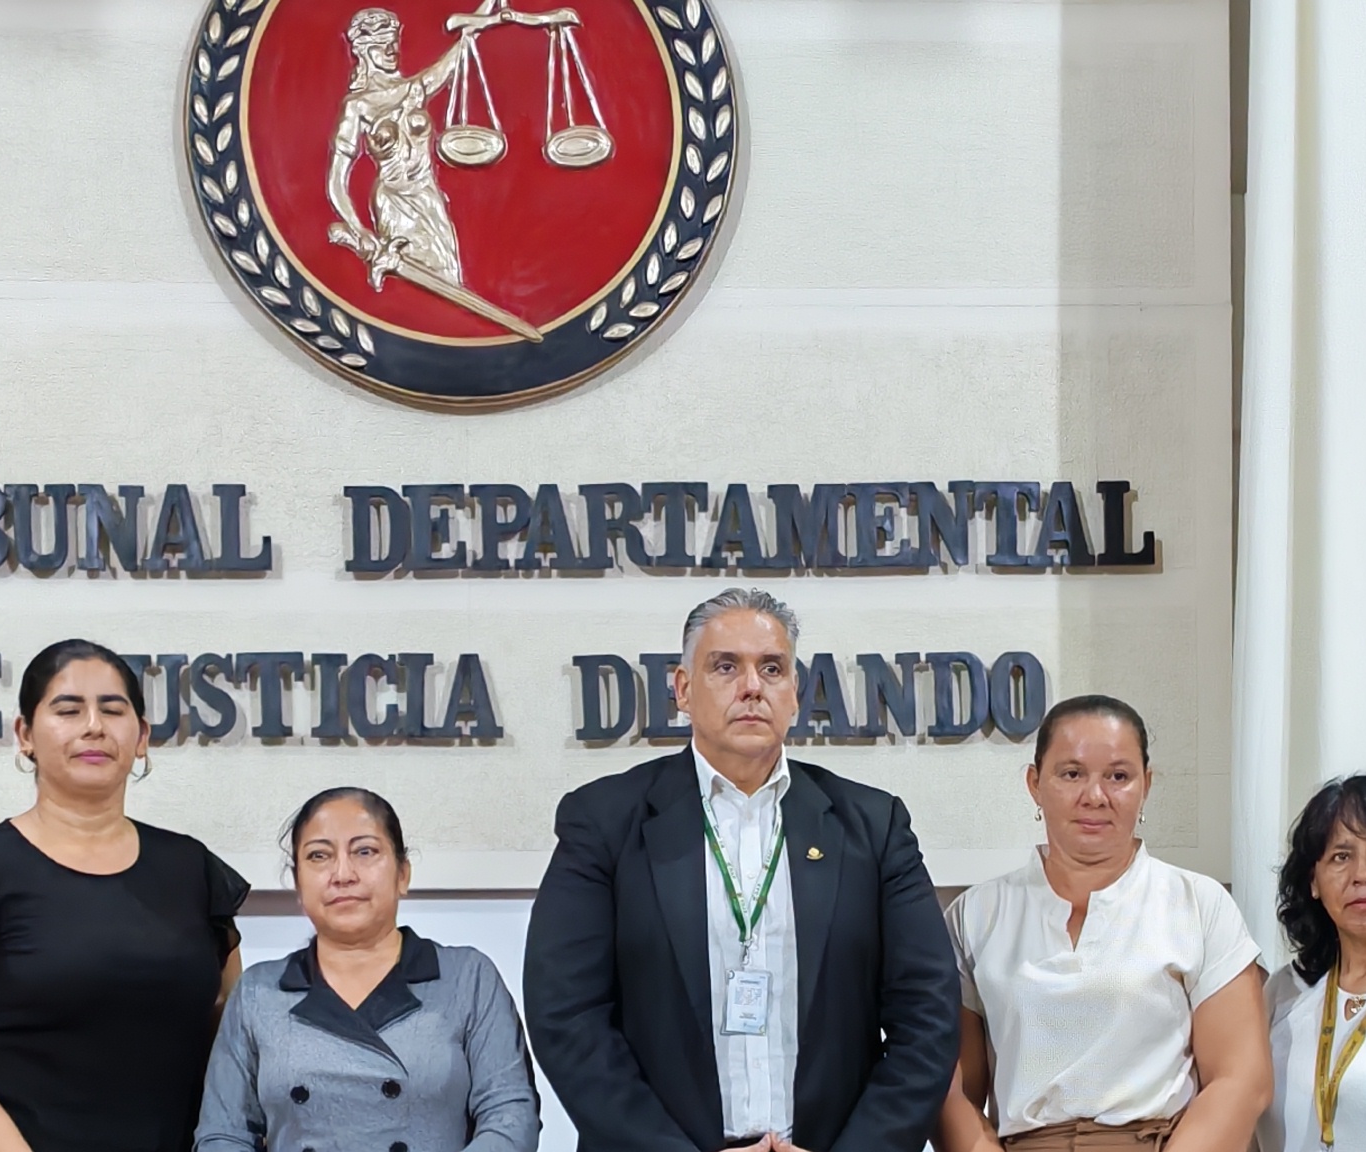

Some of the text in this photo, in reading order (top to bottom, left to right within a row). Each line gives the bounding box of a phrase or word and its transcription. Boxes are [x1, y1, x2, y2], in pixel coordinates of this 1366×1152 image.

[343, 480, 1156, 573] DEPARTAMENTAL
[119, 652, 504, 740] USTICIA
[784, 650, 1047, 742] ANDO
